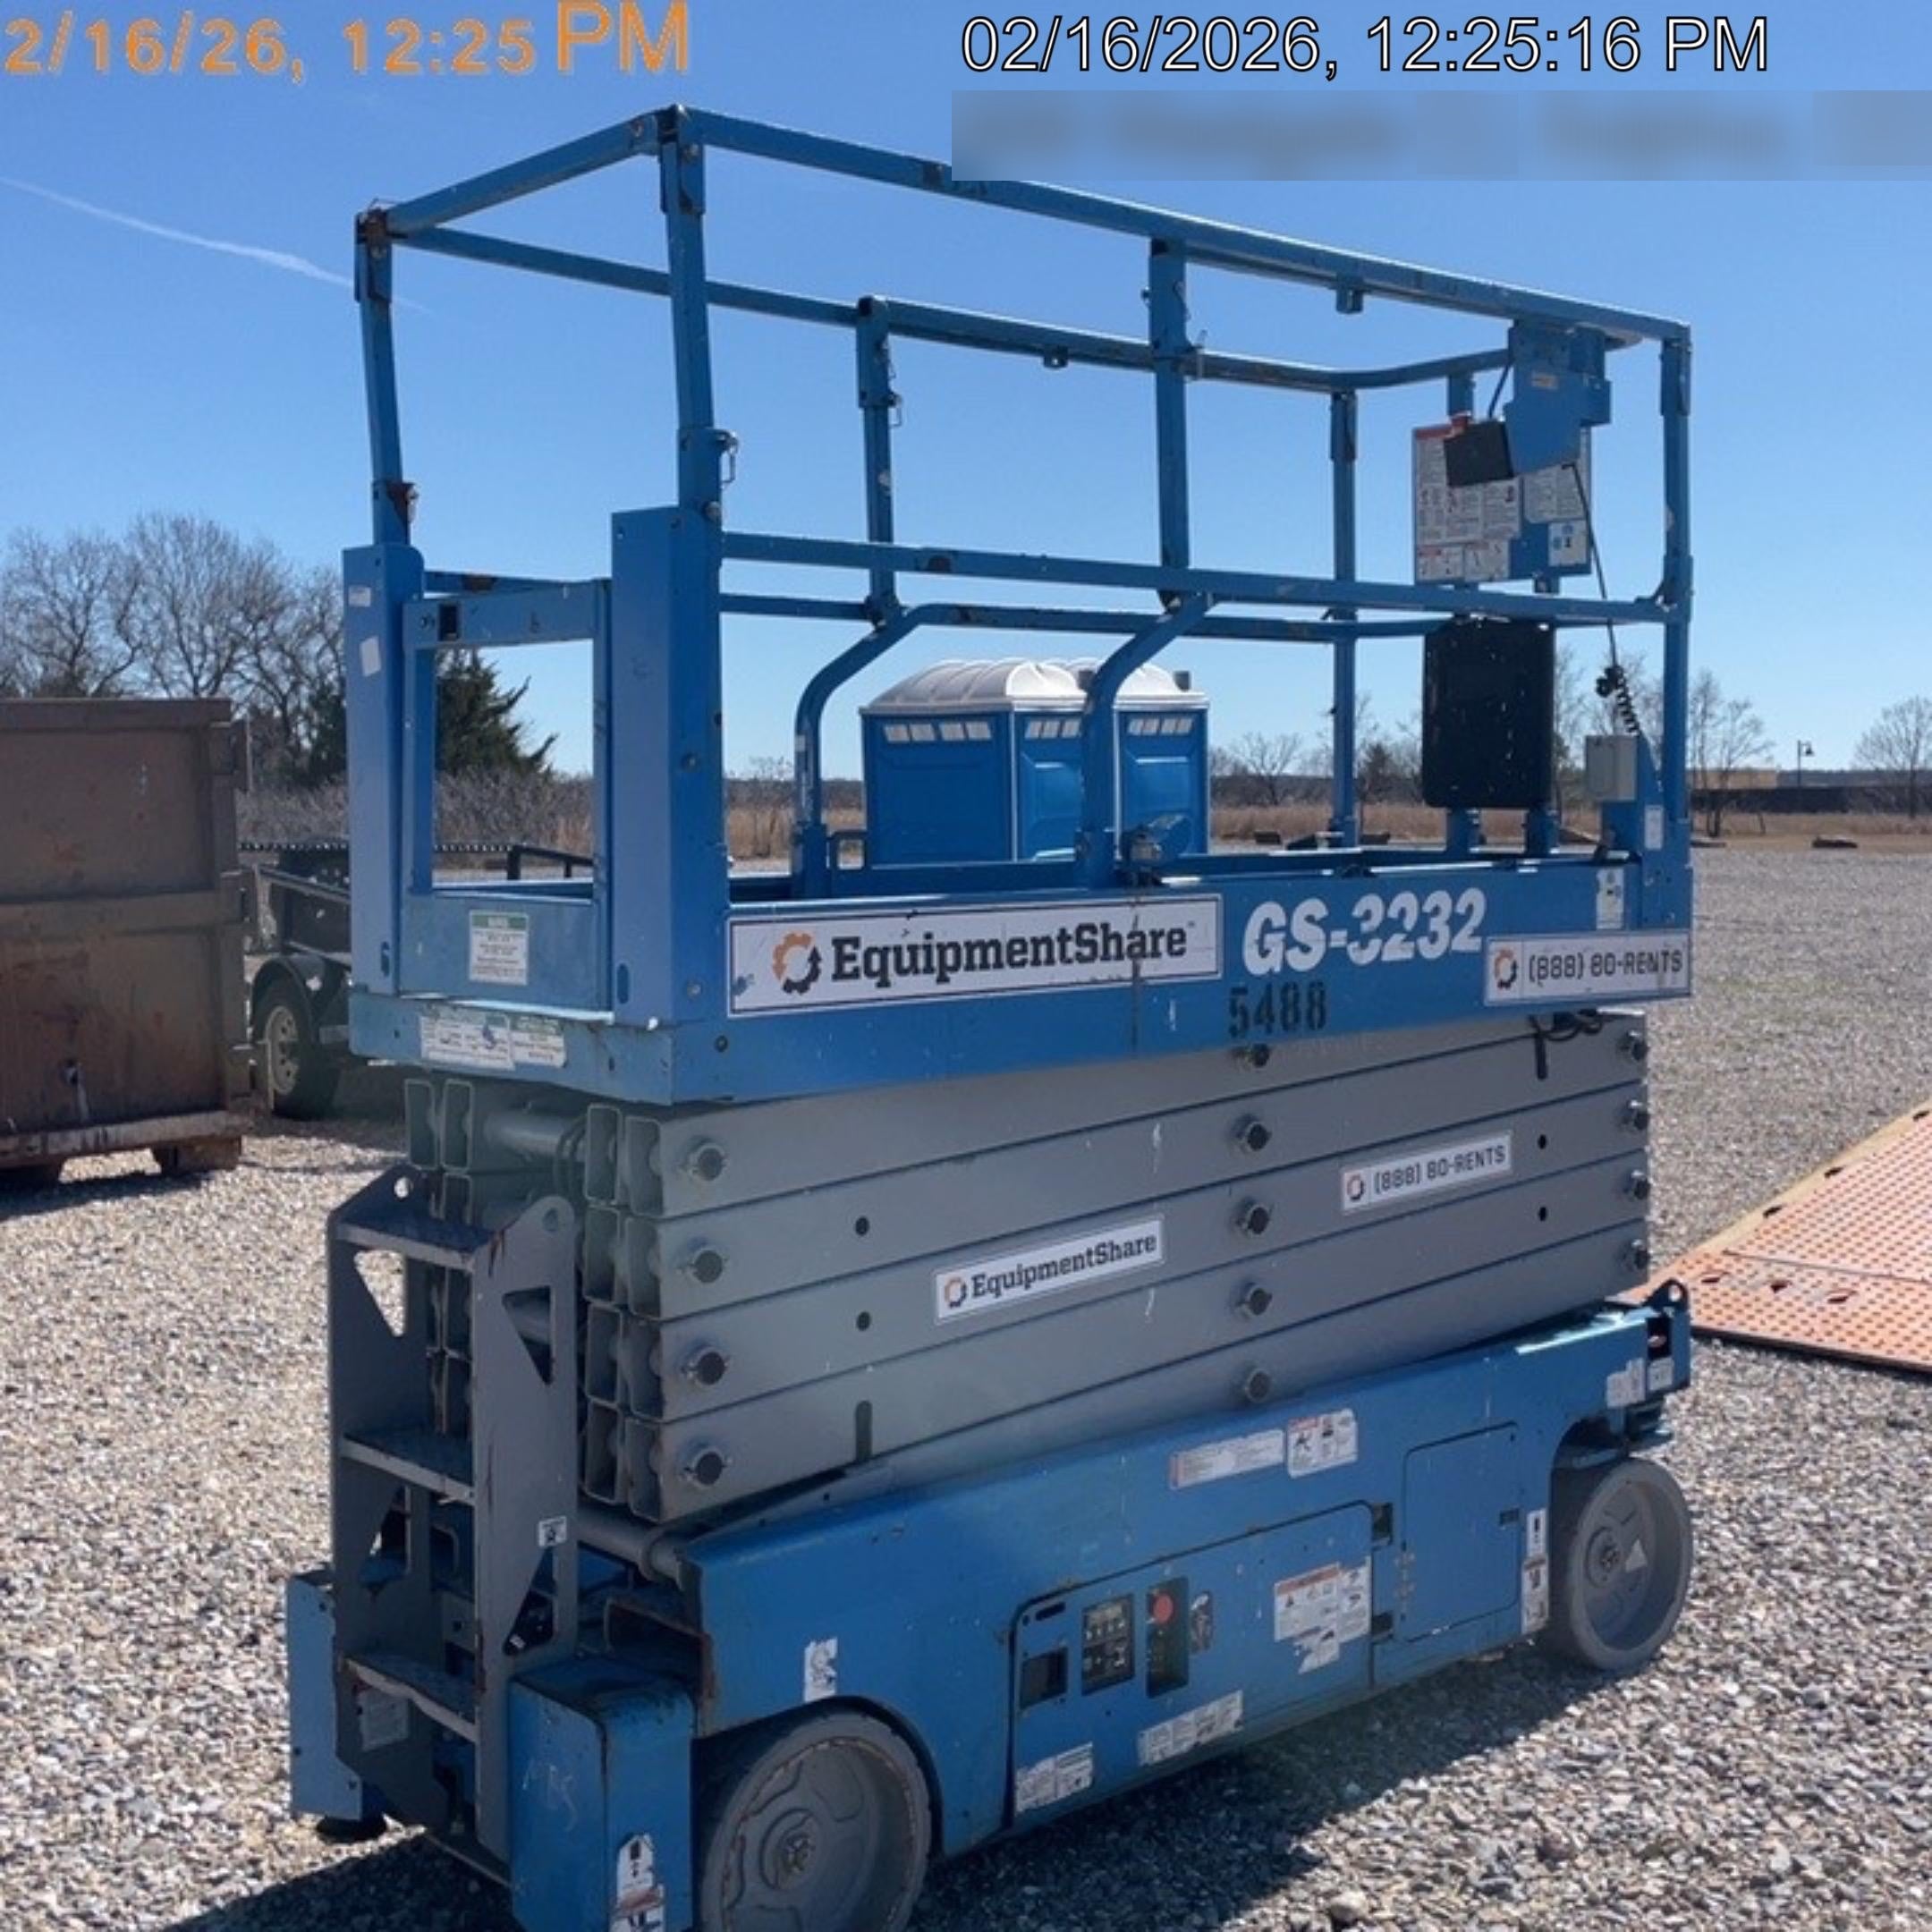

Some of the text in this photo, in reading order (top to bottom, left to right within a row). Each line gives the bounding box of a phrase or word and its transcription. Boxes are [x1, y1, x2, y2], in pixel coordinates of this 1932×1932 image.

[831, 922, 1188, 987] EquipmentShare
[1241, 887, 1487, 976] GS-3232
[1528, 949, 1683, 983] (888) 80-RENTS
[1228, 980, 1328, 1038] 5488
[970, 1234, 1157, 1299] EquipmentShare
